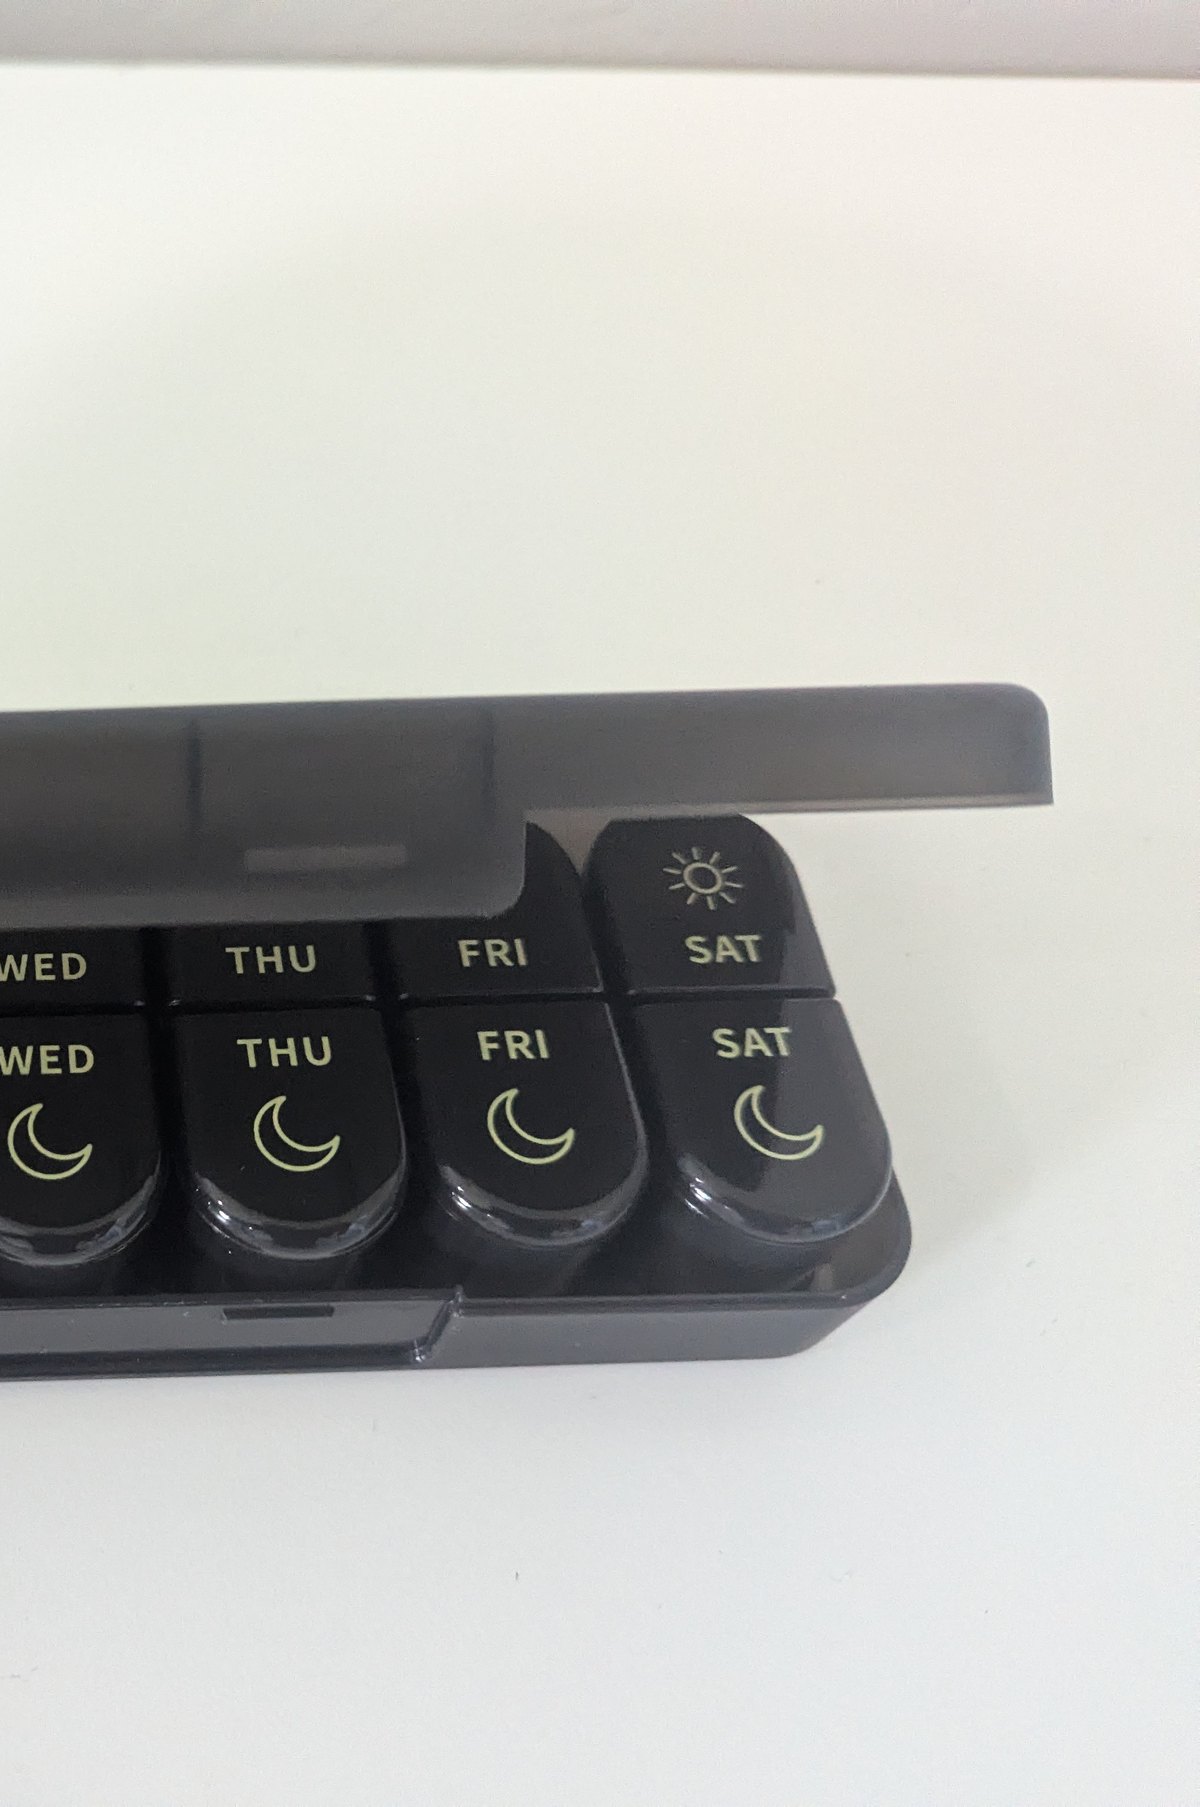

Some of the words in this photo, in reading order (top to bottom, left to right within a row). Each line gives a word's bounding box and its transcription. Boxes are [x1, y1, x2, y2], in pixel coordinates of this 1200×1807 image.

[225, 945, 317, 976] THU
[459, 938, 527, 968] FRI
[685, 935, 763, 965] SAT
[235, 1035, 333, 1069] THU
[477, 1029, 551, 1061] FRI
[713, 1026, 791, 1060] SAT
